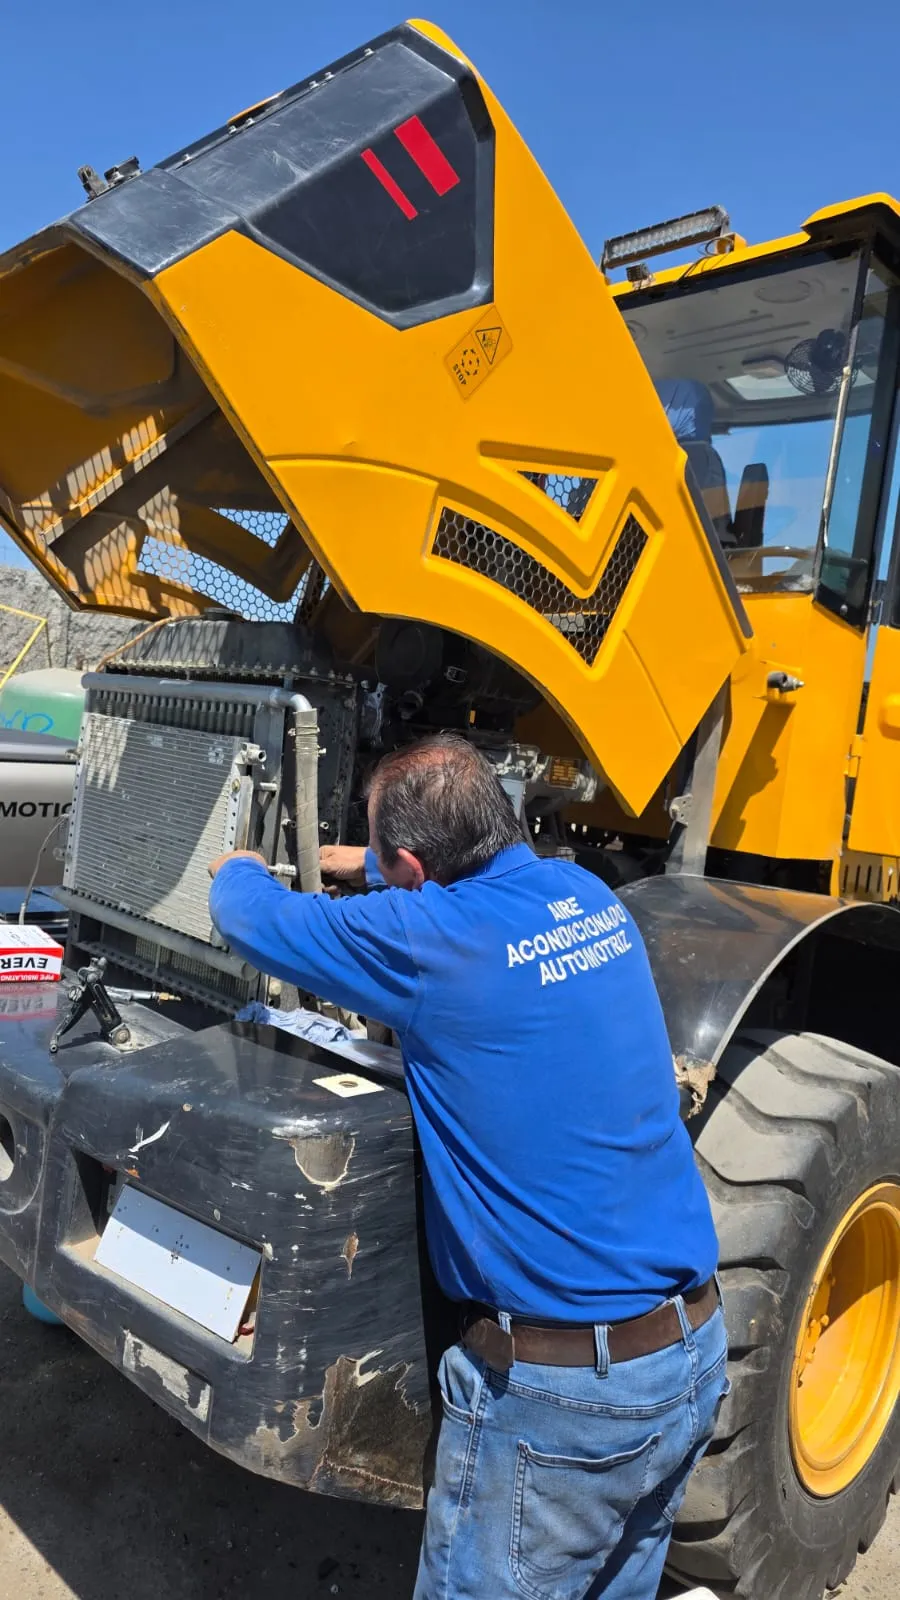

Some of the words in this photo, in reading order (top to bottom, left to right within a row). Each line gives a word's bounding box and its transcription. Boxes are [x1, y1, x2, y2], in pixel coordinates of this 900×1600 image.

[453, 364, 466, 384] STOP
[547, 896, 584, 921] AIRE
[507, 904, 627, 967] ACONDICIONADO
[1, 957, 48, 969] EVER
[540, 930, 632, 985] AUTOMOTRIZ
